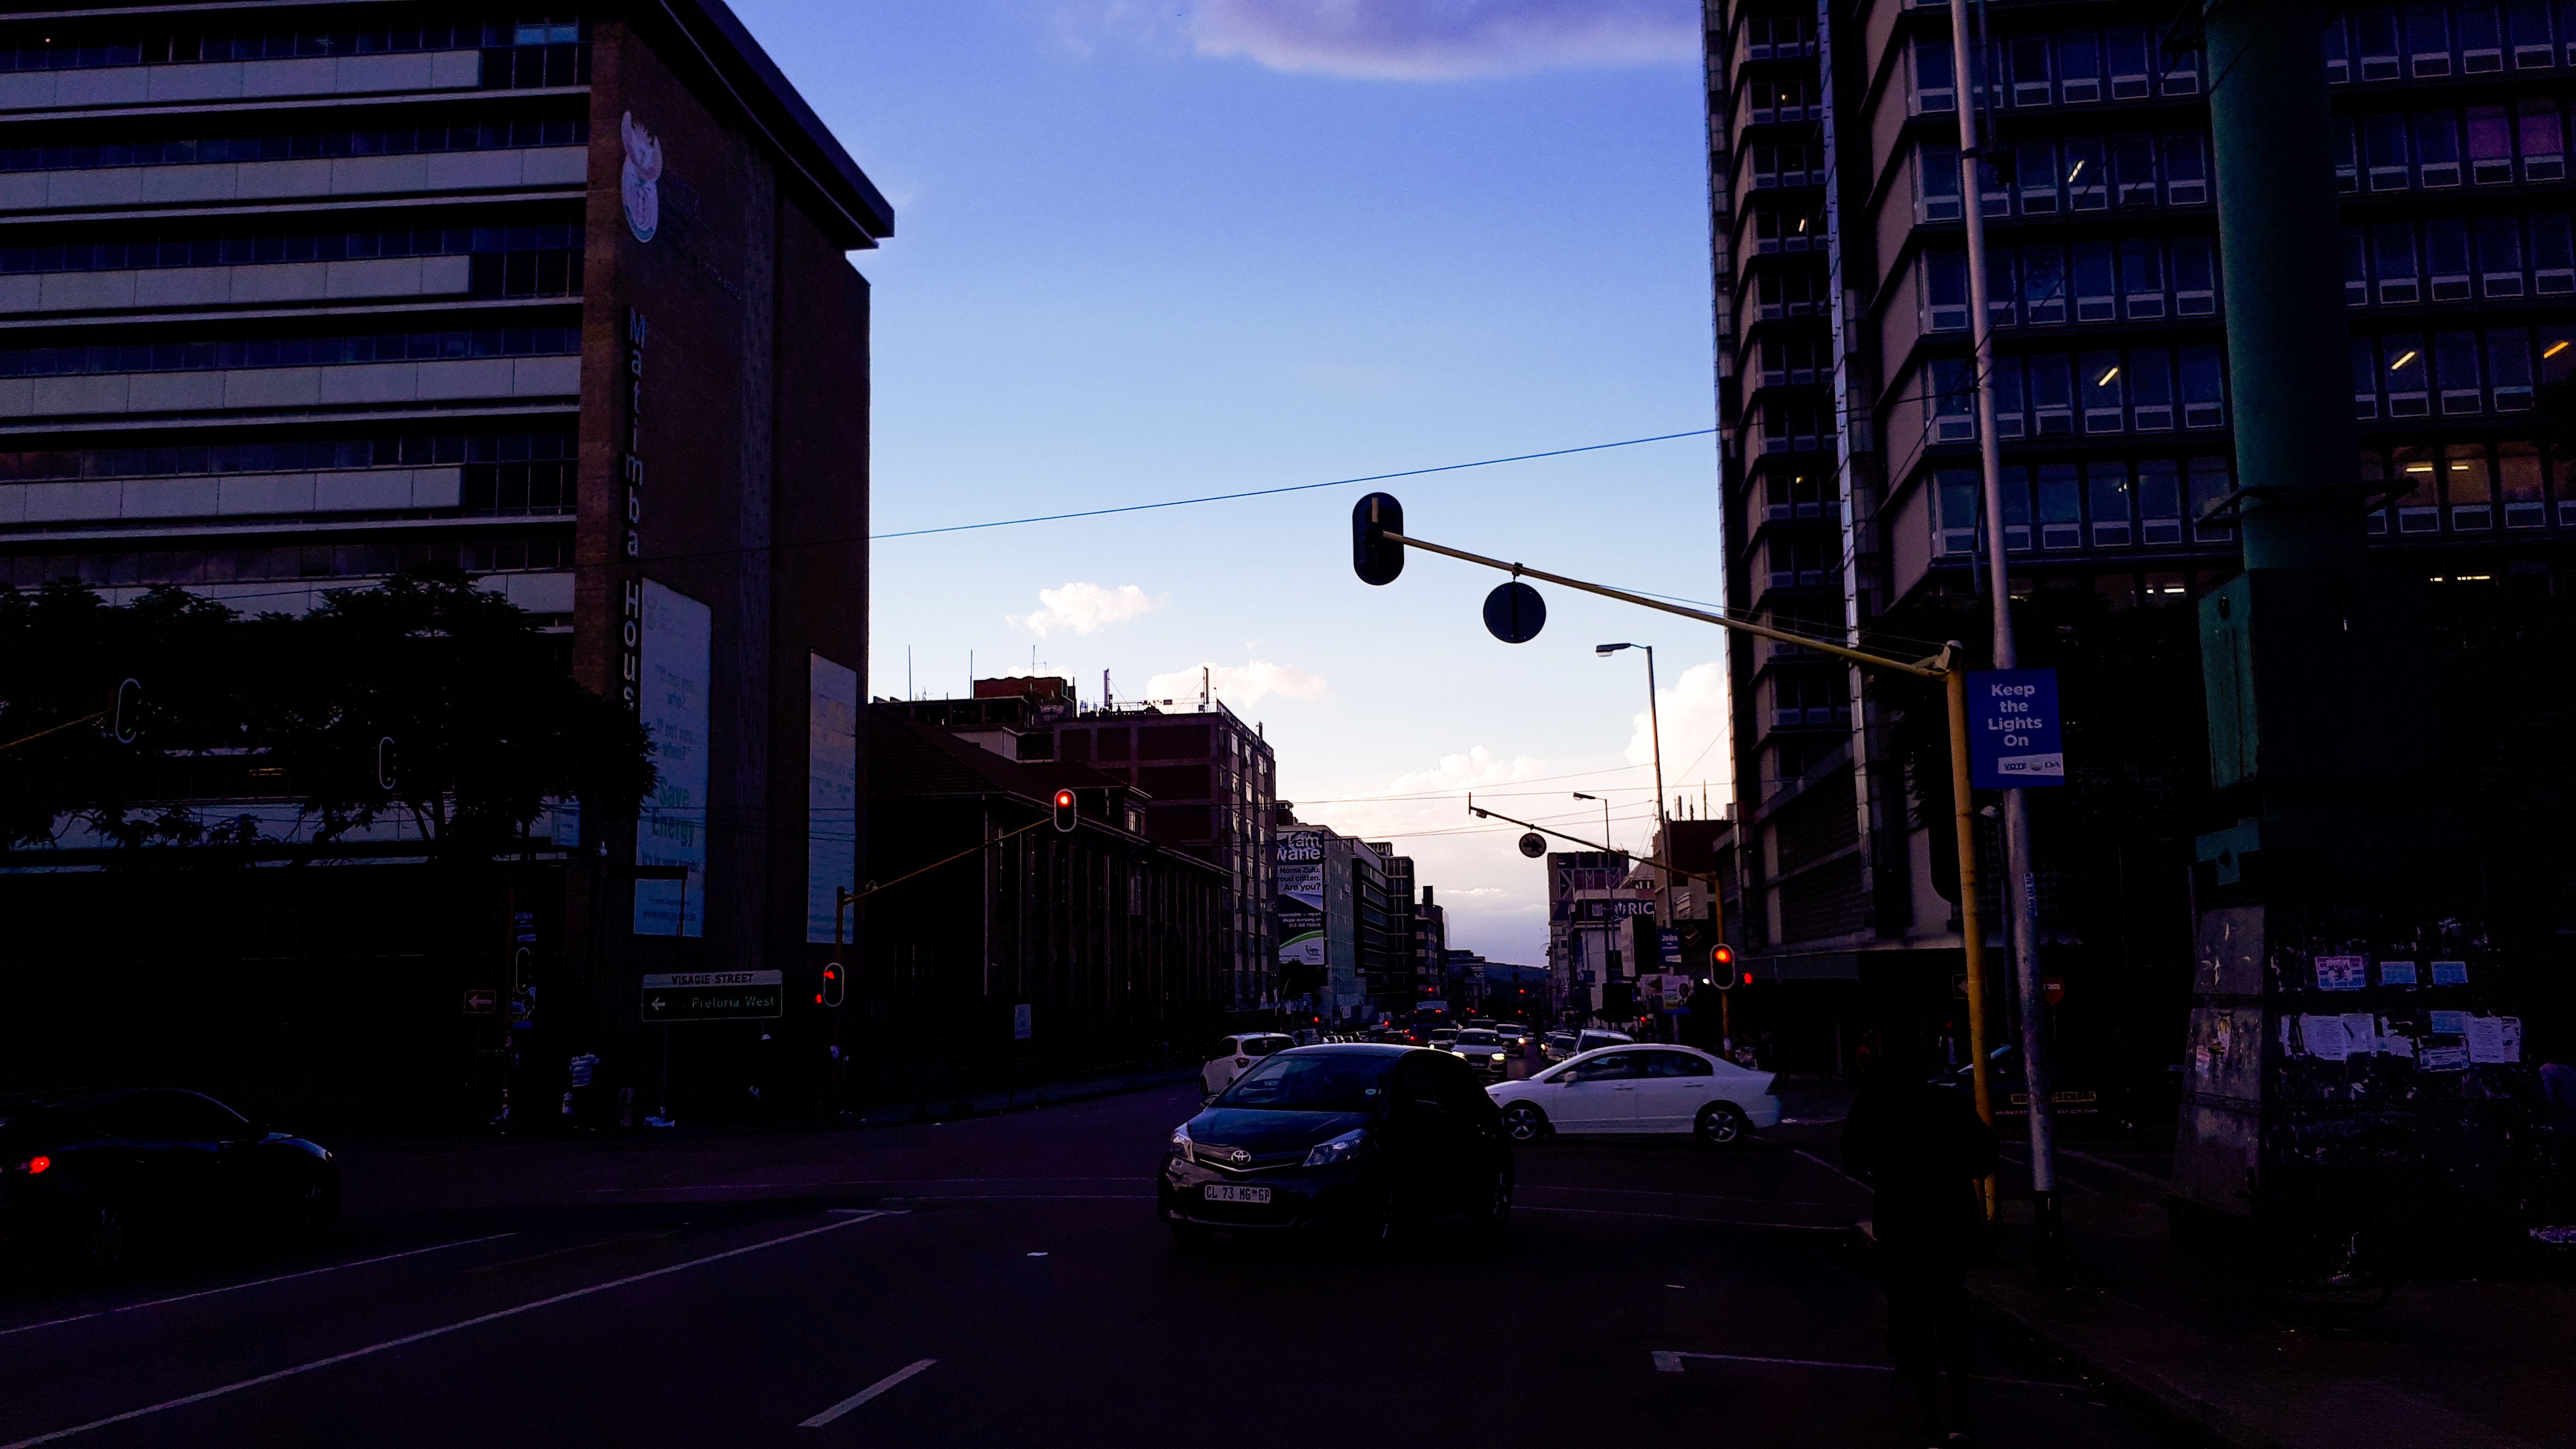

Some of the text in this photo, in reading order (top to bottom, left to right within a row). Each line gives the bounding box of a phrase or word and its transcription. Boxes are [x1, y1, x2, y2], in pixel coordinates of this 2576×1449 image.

[623, 307, 647, 712] Matimba Hous
[1991, 684, 2035, 697] Keep
[2000, 700, 2029, 713] the
[1988, 717, 2043, 732] Lights
[2004, 734, 2029, 746] On
[660, 776, 689, 808] Save
[652, 807, 694, 847] Energy
[1276, 848, 1321, 861] wane
[1301, 882, 1320, 892] you?
[671, 973, 754, 985] VISAGIE STREET
[692, 996, 740, 1008] Pretoria
[744, 995, 774, 1007] West
[1206, 1186, 1218, 1199] CL
[1223, 1186, 1234, 1199] 73
[1258, 1188, 1270, 1201] GP
